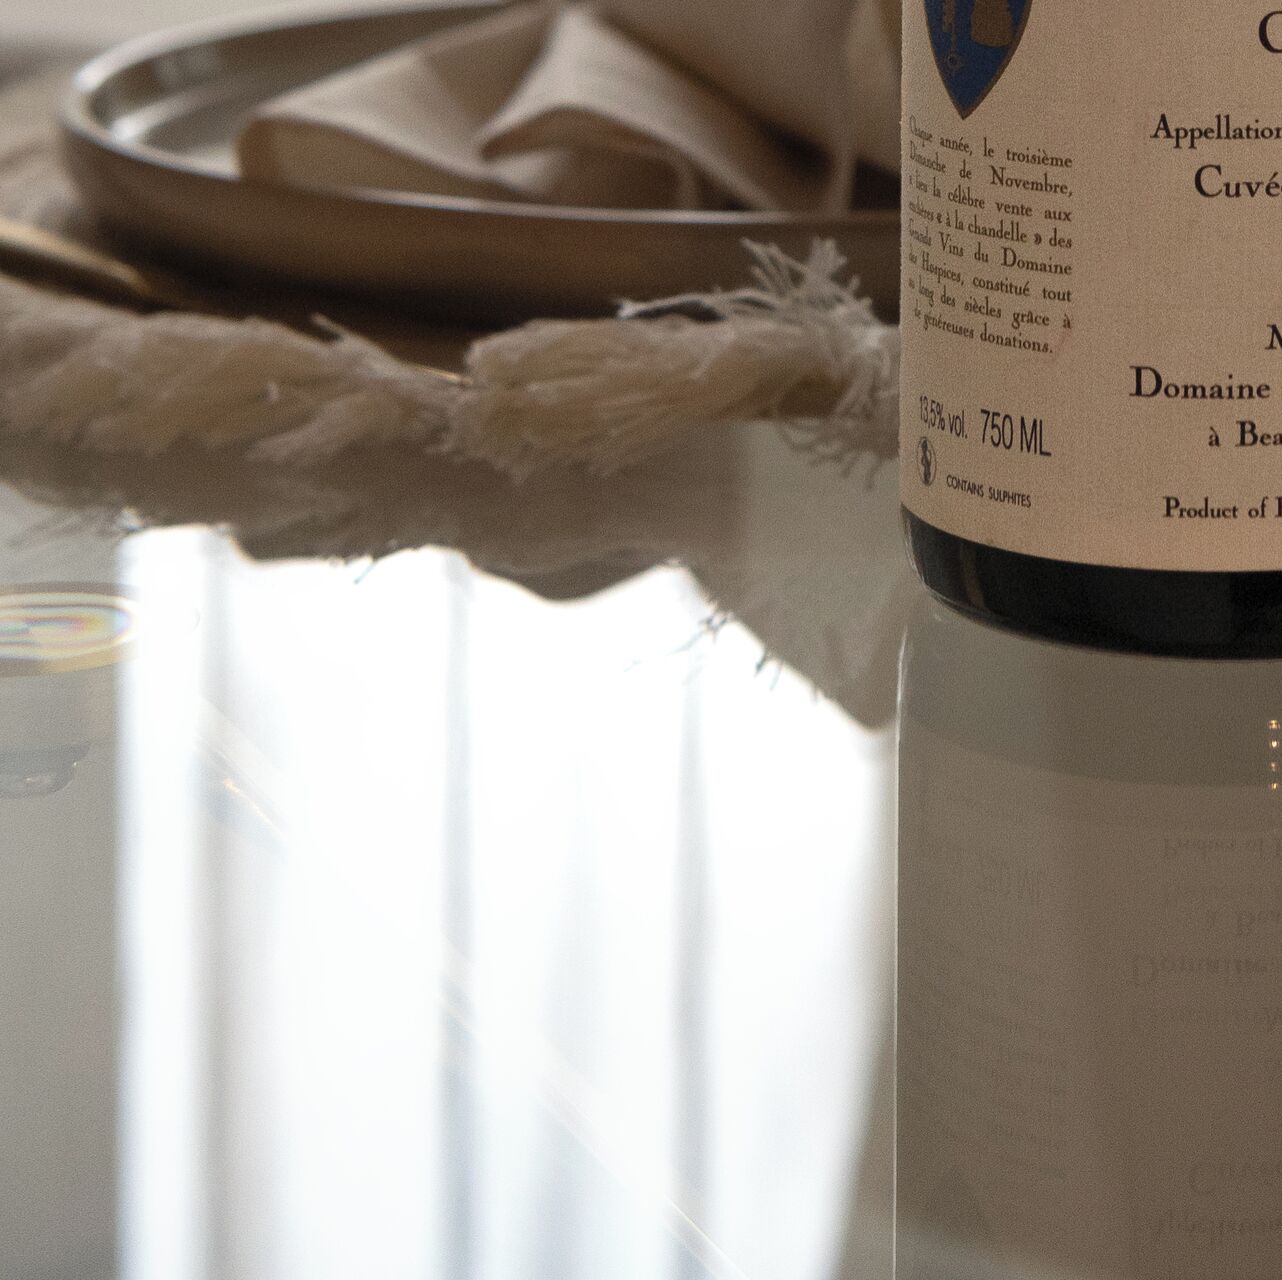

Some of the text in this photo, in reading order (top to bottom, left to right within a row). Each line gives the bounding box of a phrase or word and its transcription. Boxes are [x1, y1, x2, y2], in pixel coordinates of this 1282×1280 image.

[910, 141, 1073, 197] Dimanche de Novembre,
[940, 137, 973, 157] année,
[983, 137, 995, 158] le
[1006, 147, 1073, 168] troisième
[933, 176, 941, 197] la
[948, 184, 985, 209] célèbre
[995, 201, 1033, 217] vente
[1044, 209, 1072, 222] aux
[946, 212, 951, 227] à
[955, 209, 963, 231] la
[968, 214, 1027, 243] chandelle
[1049, 227, 1073, 248] des
[939, 231, 964, 257] Vins
[974, 241, 989, 263] du
[1001, 246, 1073, 275] Domaine
[921, 251, 964, 285] Hospices,
[972, 277, 1030, 297] constitué
[1042, 287, 1072, 302] tout
[940, 285, 956, 307] des
[964, 296, 1002, 318] siècles
[1012, 311, 1050, 329] grâce
[1062, 313, 1072, 329] à
[923, 314, 974, 339] généreuses
[980, 322, 1053, 353] donations.
[1129, 365, 1271, 399] Domaine
[947, 410, 968, 439] vol.
[980, 408, 1014, 450] 750
[1020, 415, 1052, 456] ML
[1208, 427, 1221, 447] à
[946, 474, 1032, 508] CONTAINS SULPHITES
[1163, 496, 1239, 519] Product
[1248, 497, 1268, 518] of
